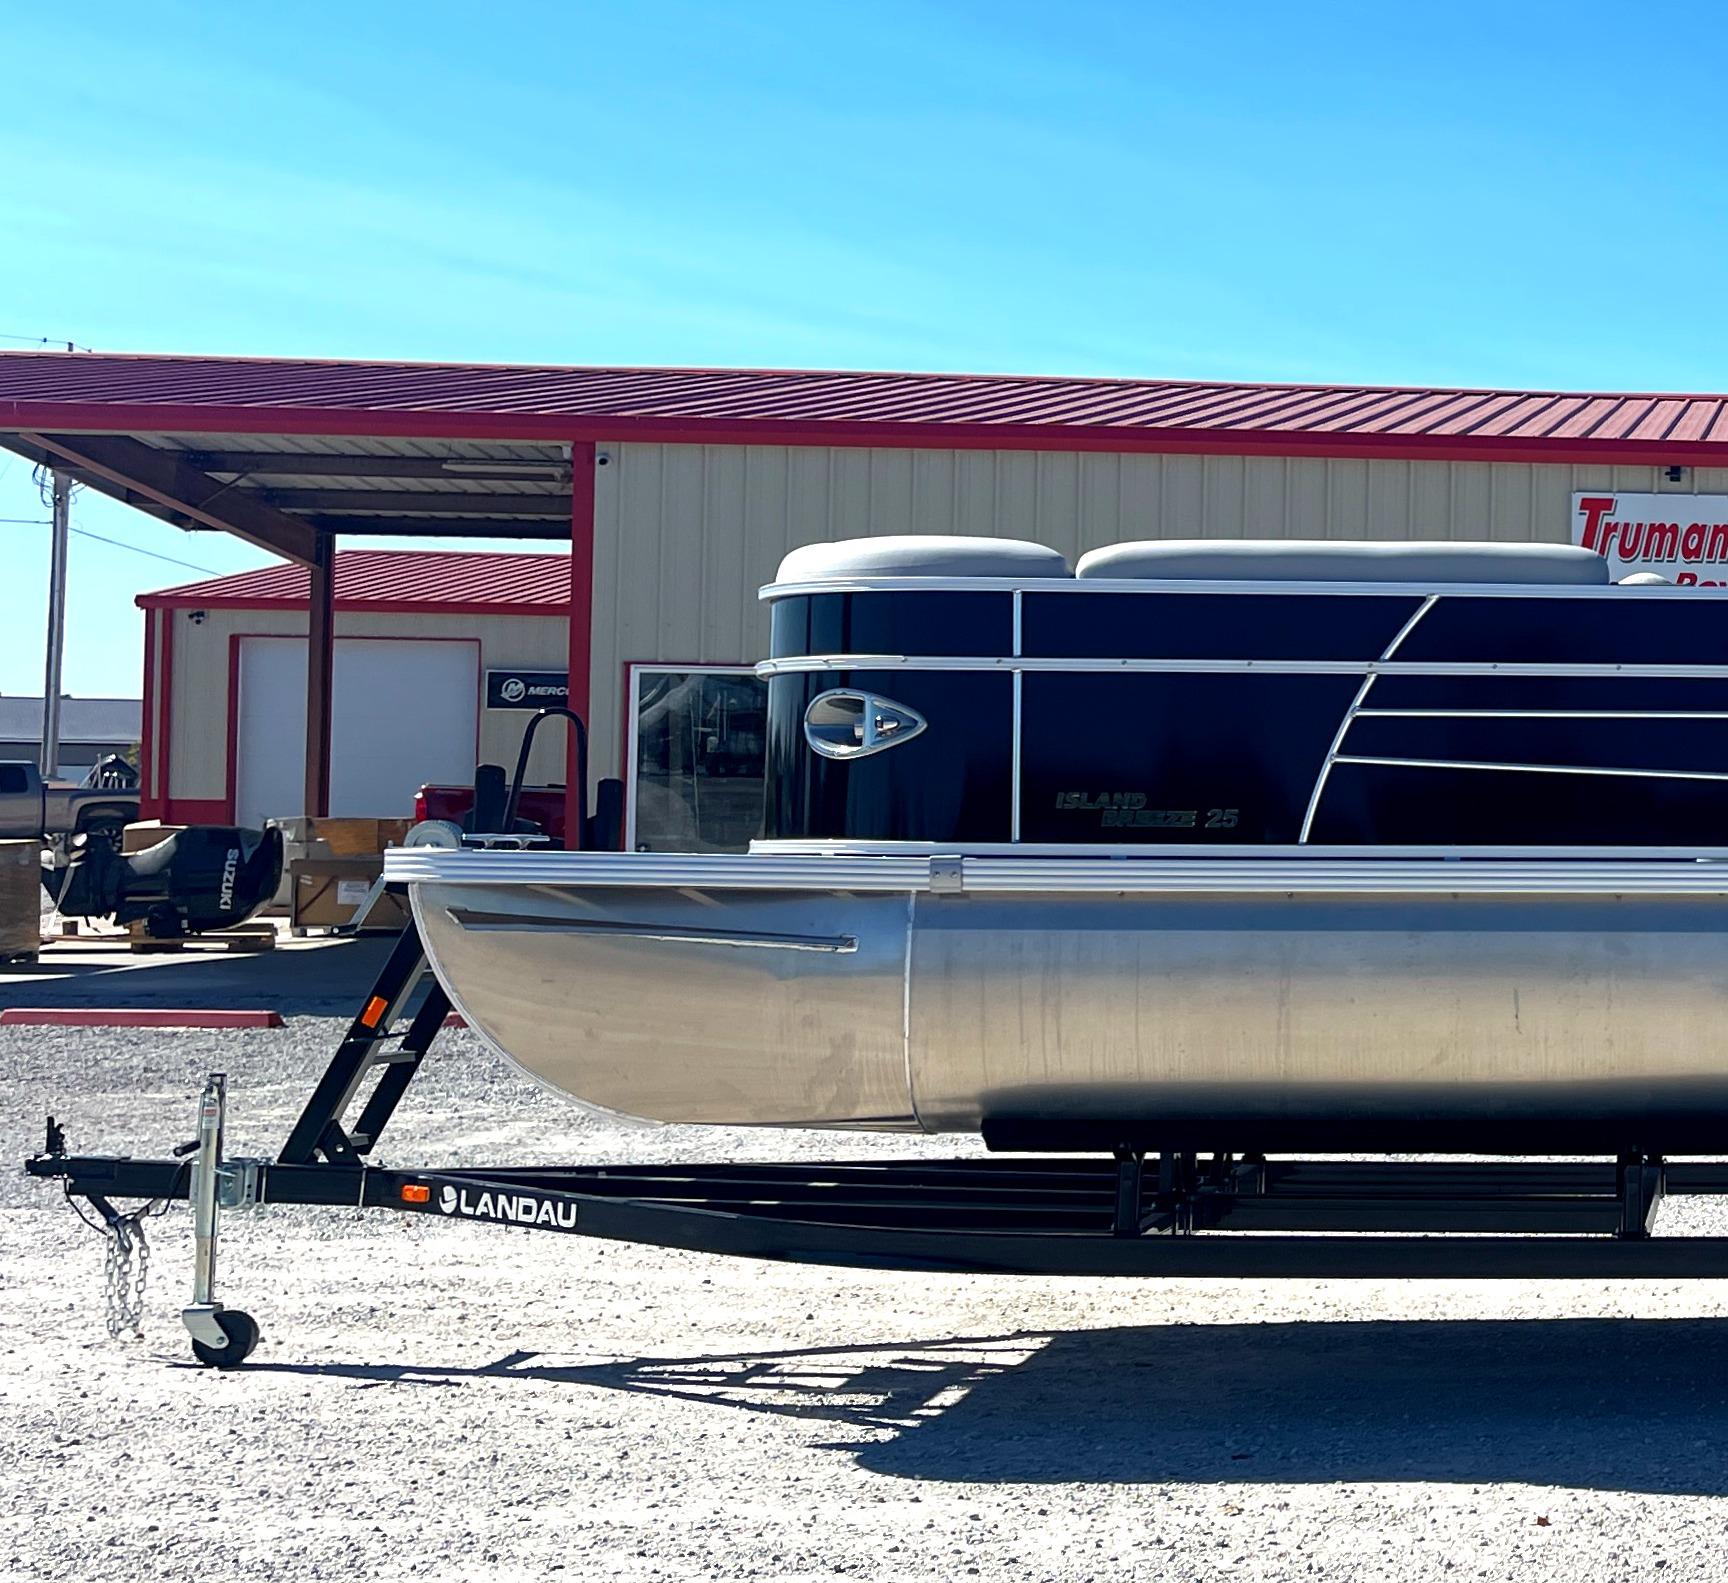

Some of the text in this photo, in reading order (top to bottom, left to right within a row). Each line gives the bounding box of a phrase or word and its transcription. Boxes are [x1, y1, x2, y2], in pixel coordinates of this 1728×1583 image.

[1055, 792, 1147, 809] ISLAND
[1204, 809, 1239, 828] 25
[219, 848, 240, 910] SUZUKI
[459, 1189, 577, 1228] LANDAU
